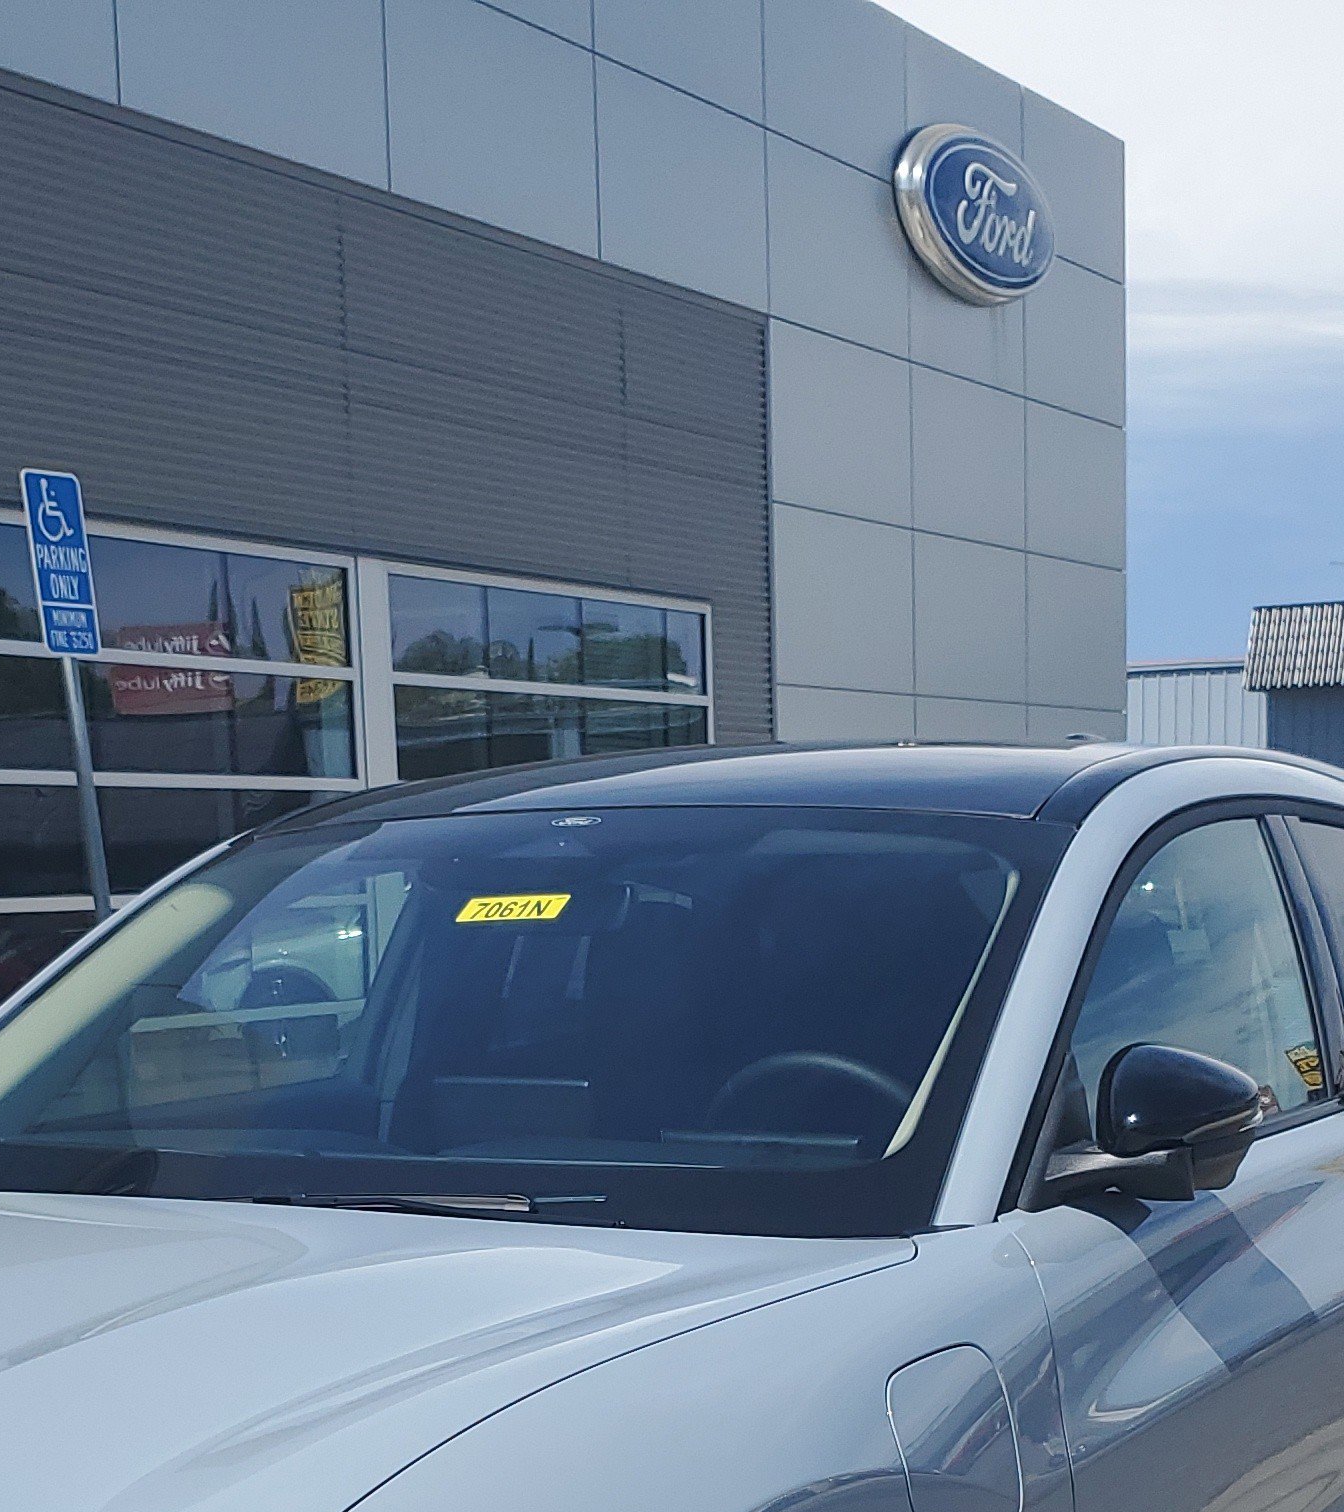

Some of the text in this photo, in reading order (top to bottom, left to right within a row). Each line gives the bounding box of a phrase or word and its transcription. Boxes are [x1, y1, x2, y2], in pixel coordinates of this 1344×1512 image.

[956, 160, 1037, 267] Ford
[36, 543, 88, 573] PARKING
[49, 573, 80, 600] ONLY
[470, 899, 553, 919] 7061N
